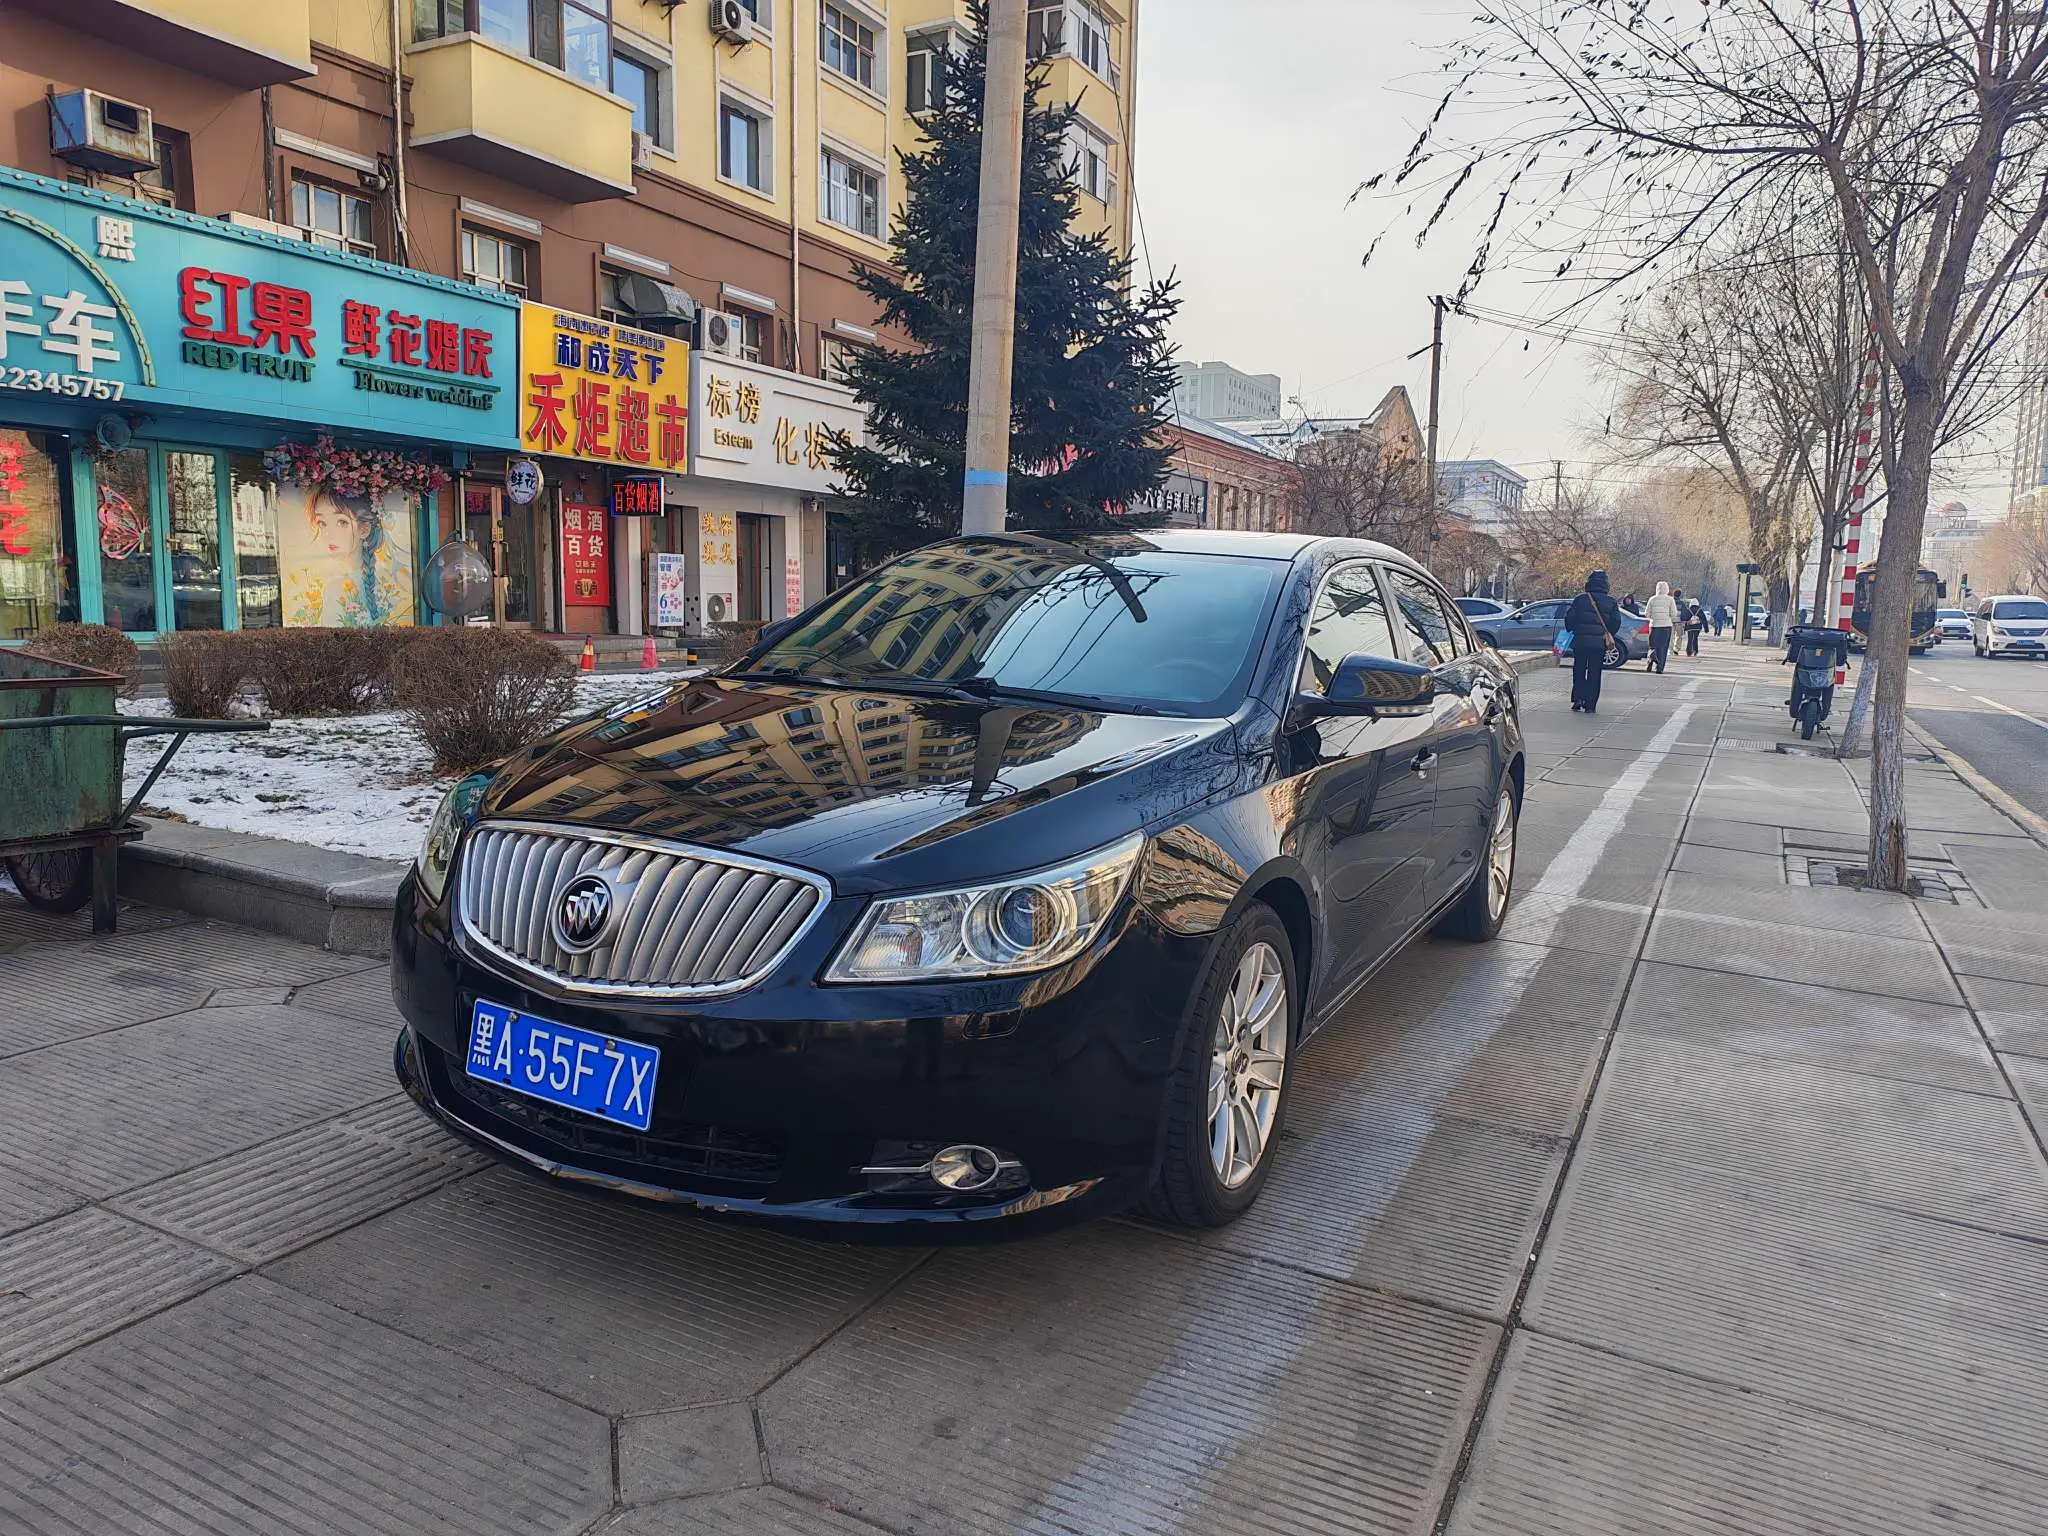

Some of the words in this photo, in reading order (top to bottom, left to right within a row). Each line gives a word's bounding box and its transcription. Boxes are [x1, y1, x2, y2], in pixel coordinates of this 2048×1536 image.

[178, 266, 316, 358] 红果
[344, 299, 493, 379] 鲜花婚庆
[556, 334, 665, 384] 和成天下
[182, 341, 240, 369] RED
[242, 352, 316, 382] FRUIT
[354, 371, 425, 399] Flowers
[425, 386, 493, 411] wedding
[707, 373, 761, 424] 标榜
[529, 372, 688, 467] 禾炬超市
[714, 428, 753, 450] Esteem
[510, 470, 537, 490] 鲜花
[614, 480, 659, 513] 百货烟酒
[564, 508, 604, 532] 烟酒
[702, 512, 733, 537] 美容
[565, 534, 604, 557] 百货
[471, 1012, 651, 1117] 黑A·55F7X
